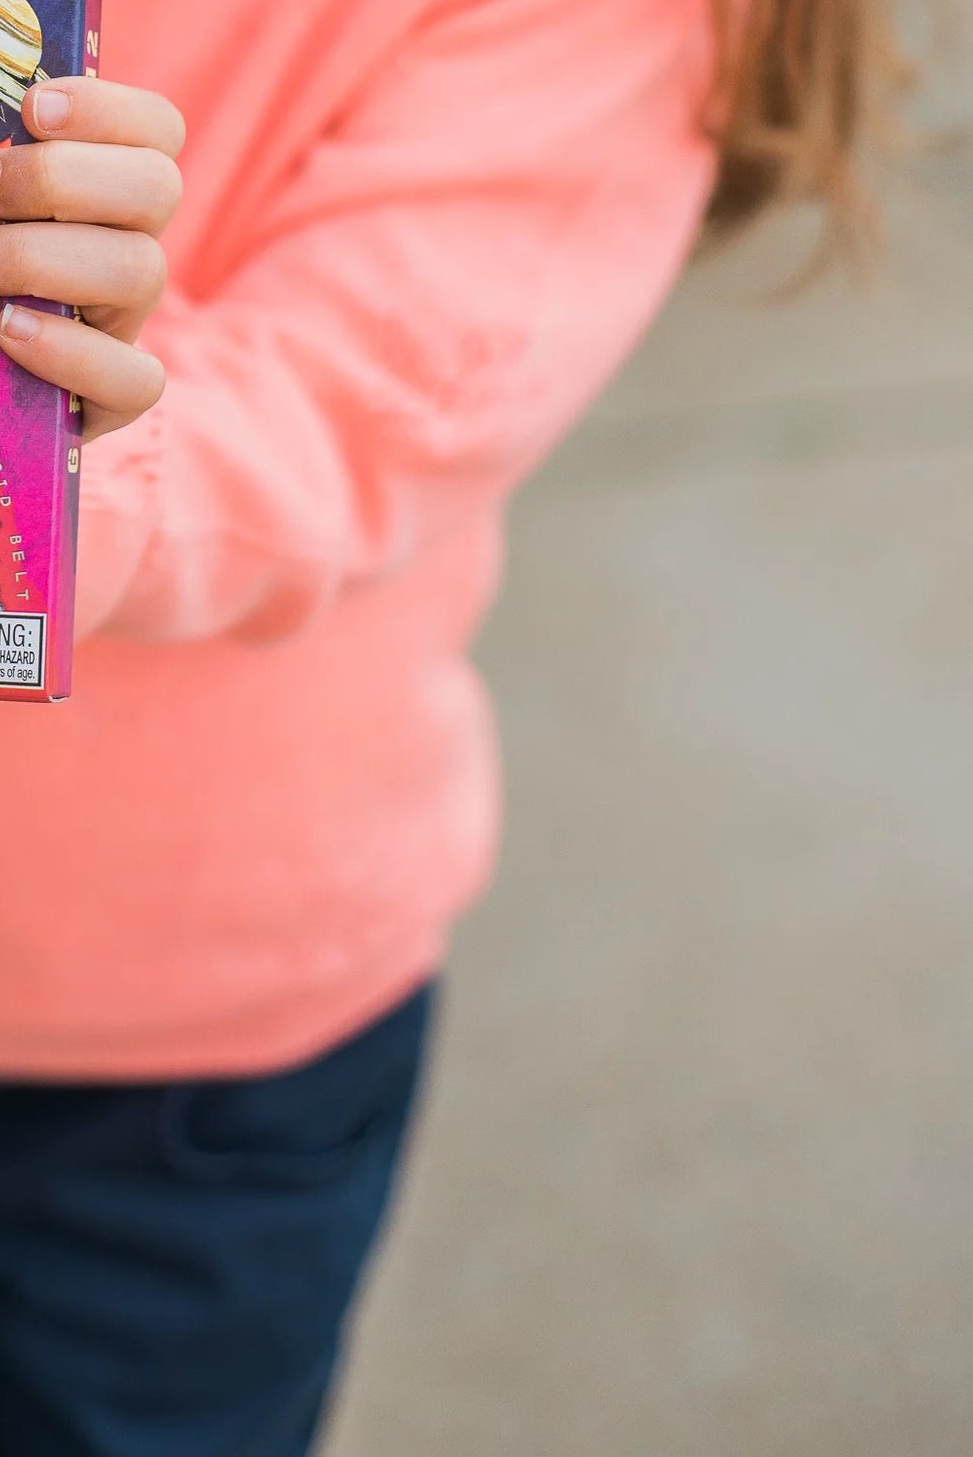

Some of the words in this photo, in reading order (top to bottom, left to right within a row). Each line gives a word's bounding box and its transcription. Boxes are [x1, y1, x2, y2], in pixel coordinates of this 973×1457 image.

[9, 534, 29, 601] BELT
[0, 650, 35, 664] HAZARD
[7, 666, 15, 677] of
[17, 668, 35, 681] age.
